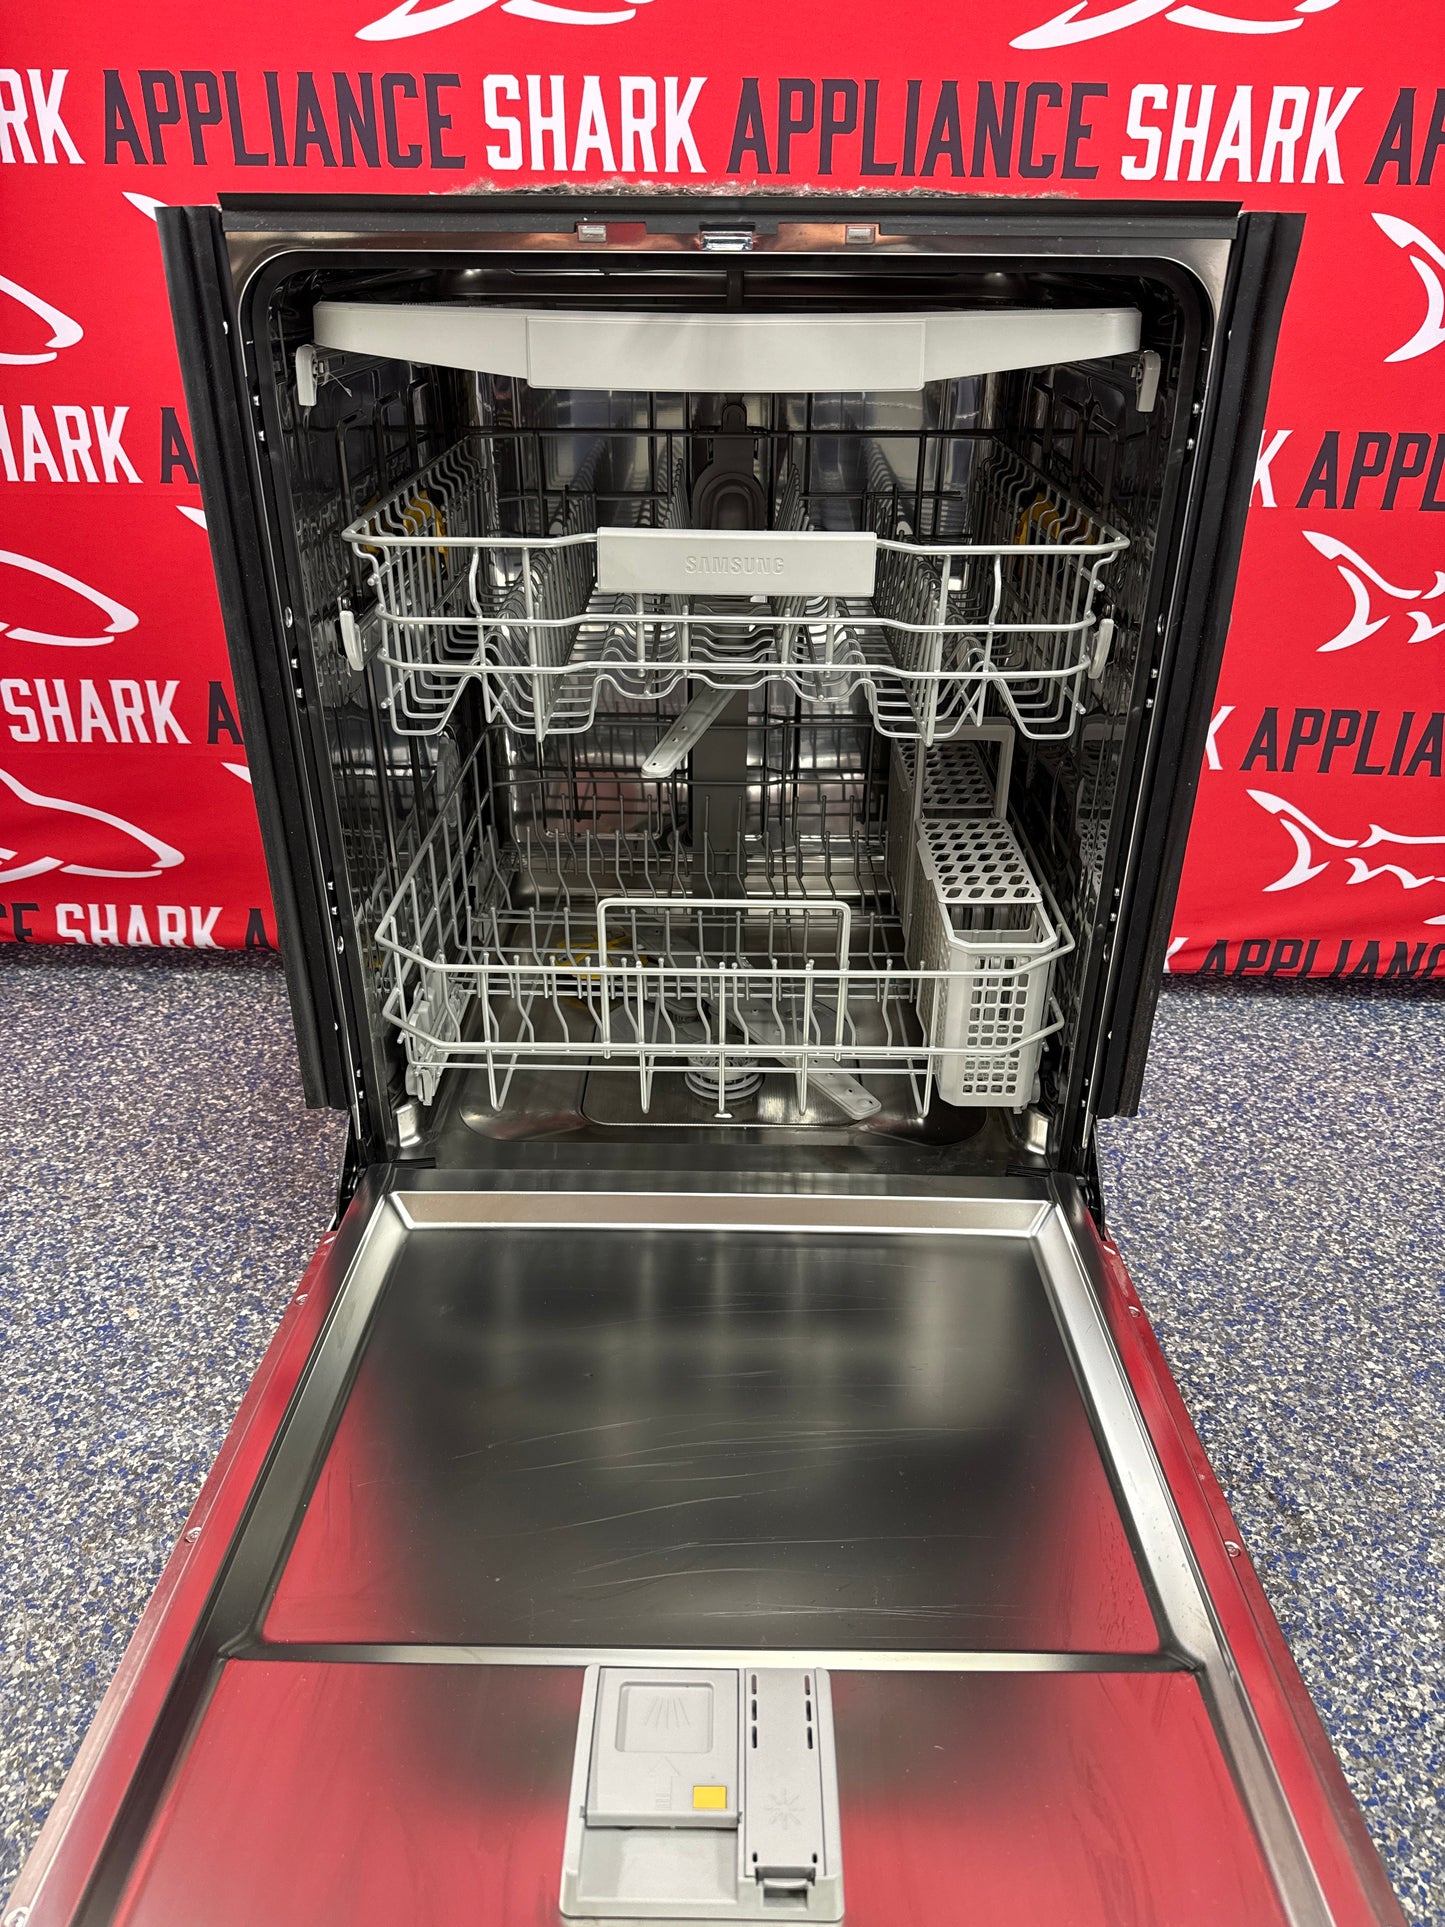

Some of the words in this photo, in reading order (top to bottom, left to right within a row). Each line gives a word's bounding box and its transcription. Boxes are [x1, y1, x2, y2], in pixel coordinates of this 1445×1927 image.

[103, 69, 466, 169] APPLIANCE
[483, 74, 708, 173] SHARK
[726, 77, 1108, 178] APPLIANCE
[1120, 83, 1364, 184] SHARK
[684, 555, 785, 575] SAMSUNG
[0, 678, 192, 744] SHARK
[55, 903, 223, 950] SHARK
